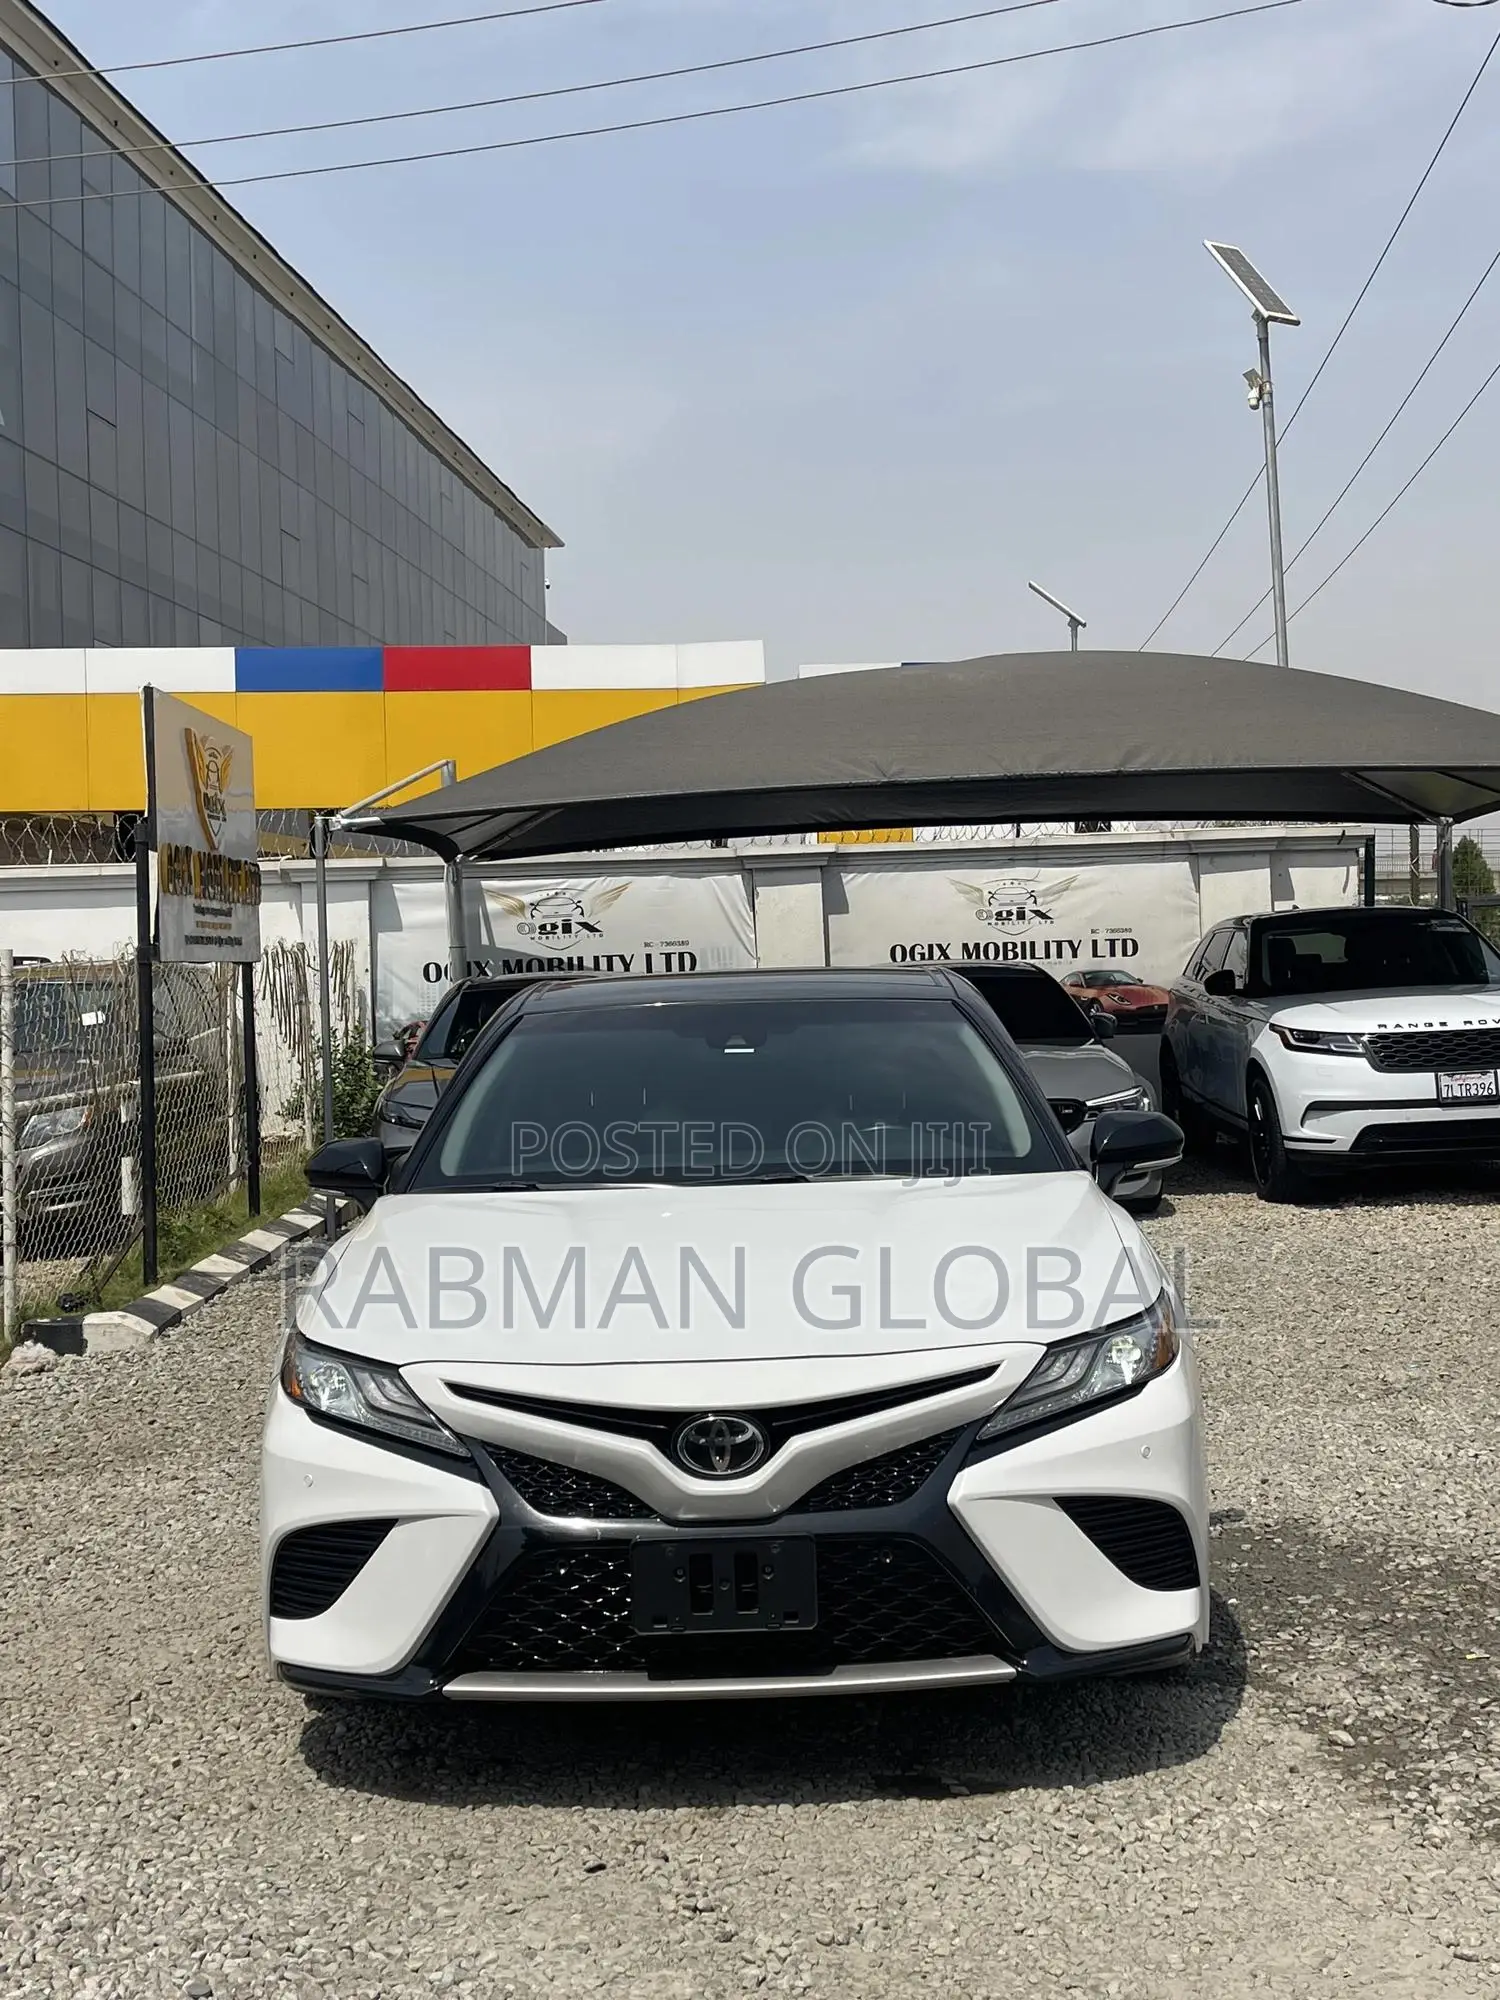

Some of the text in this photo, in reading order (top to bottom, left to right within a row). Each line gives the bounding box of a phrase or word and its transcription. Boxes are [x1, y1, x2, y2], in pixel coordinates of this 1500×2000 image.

[890, 938, 1139, 962] OGIX MOBILITY LTD
[502, 953, 634, 975] MOBILITY
[645, 951, 697, 974] LTD
[1377, 1021, 1448, 1029] RANGE
[1443, 1081, 1494, 1098] 7LTR396
